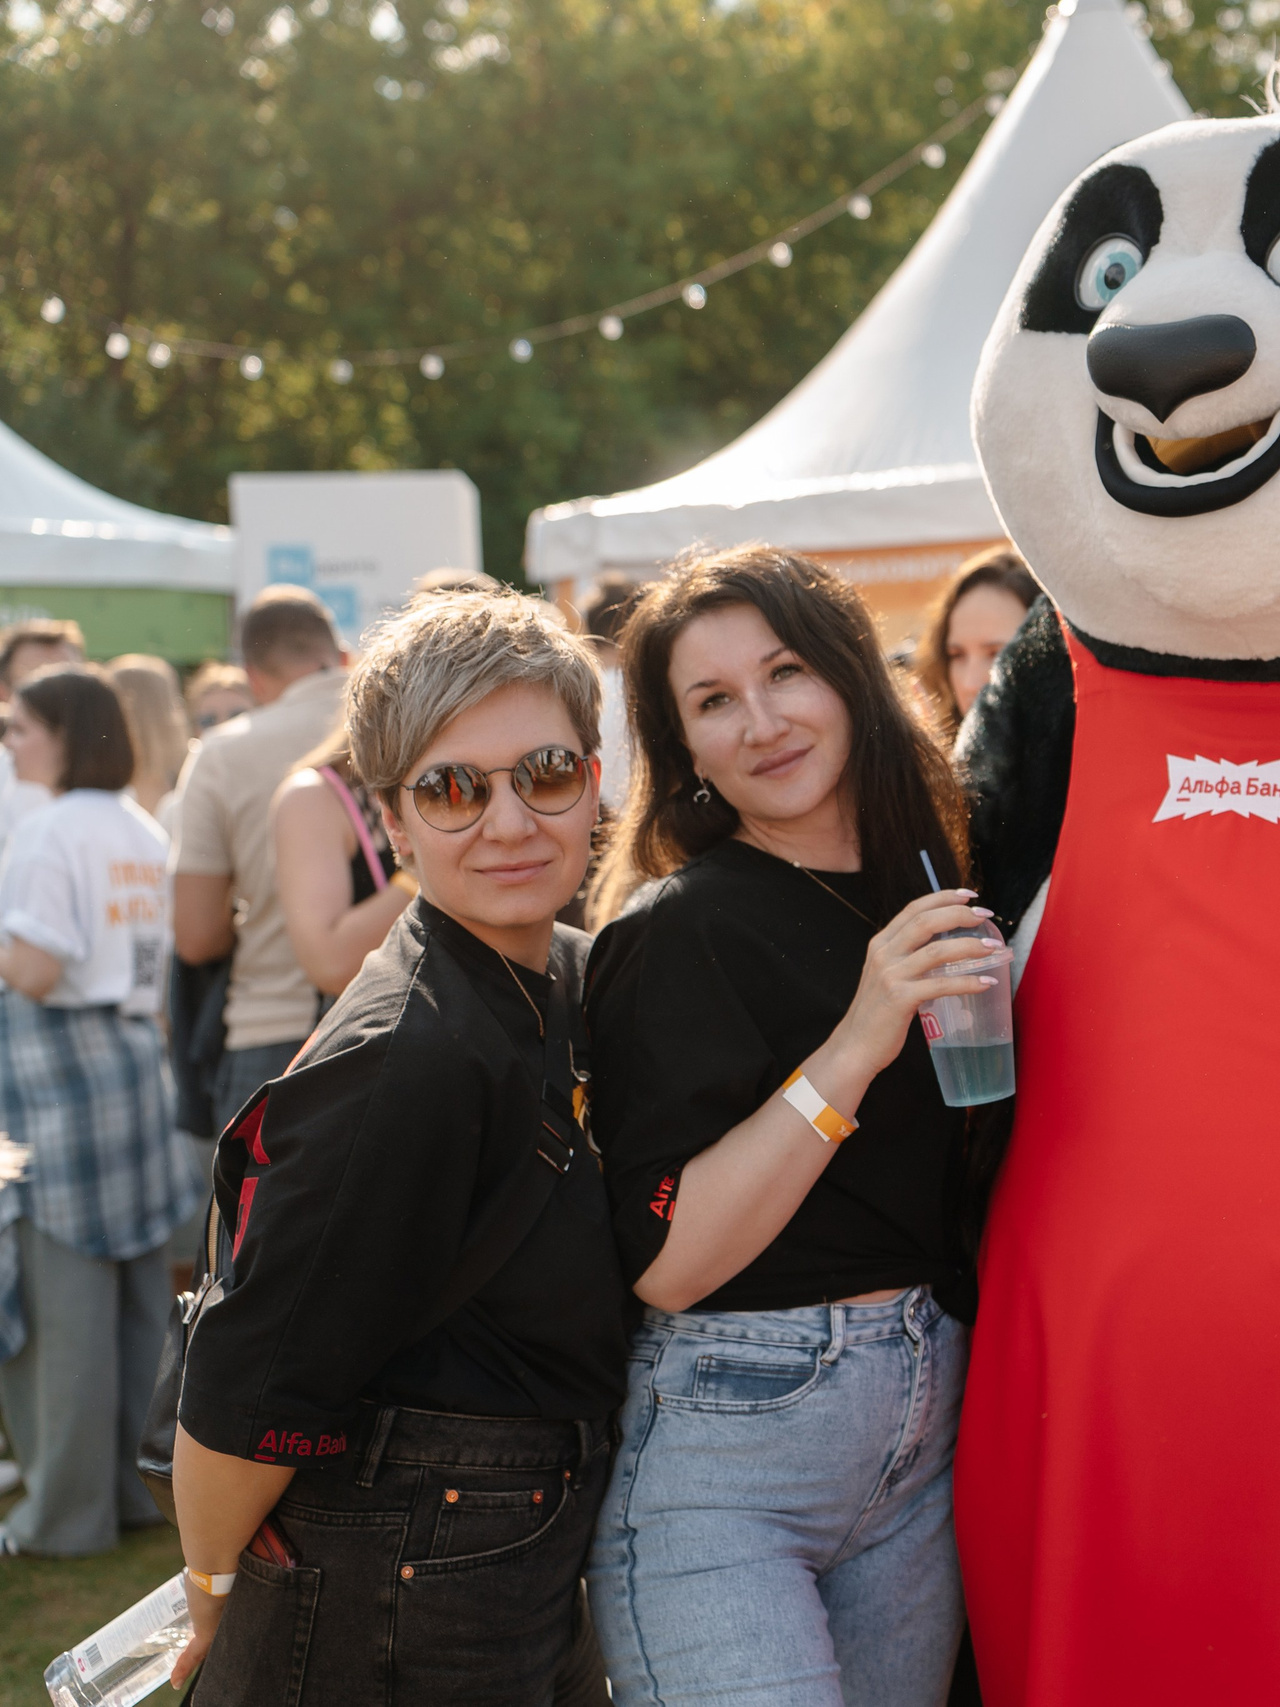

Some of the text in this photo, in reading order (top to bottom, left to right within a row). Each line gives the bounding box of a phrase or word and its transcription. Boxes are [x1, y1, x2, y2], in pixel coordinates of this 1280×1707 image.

[1176, 776, 1241, 802] Альфа
[254, 1429, 347, 1462] Alfa Ban
